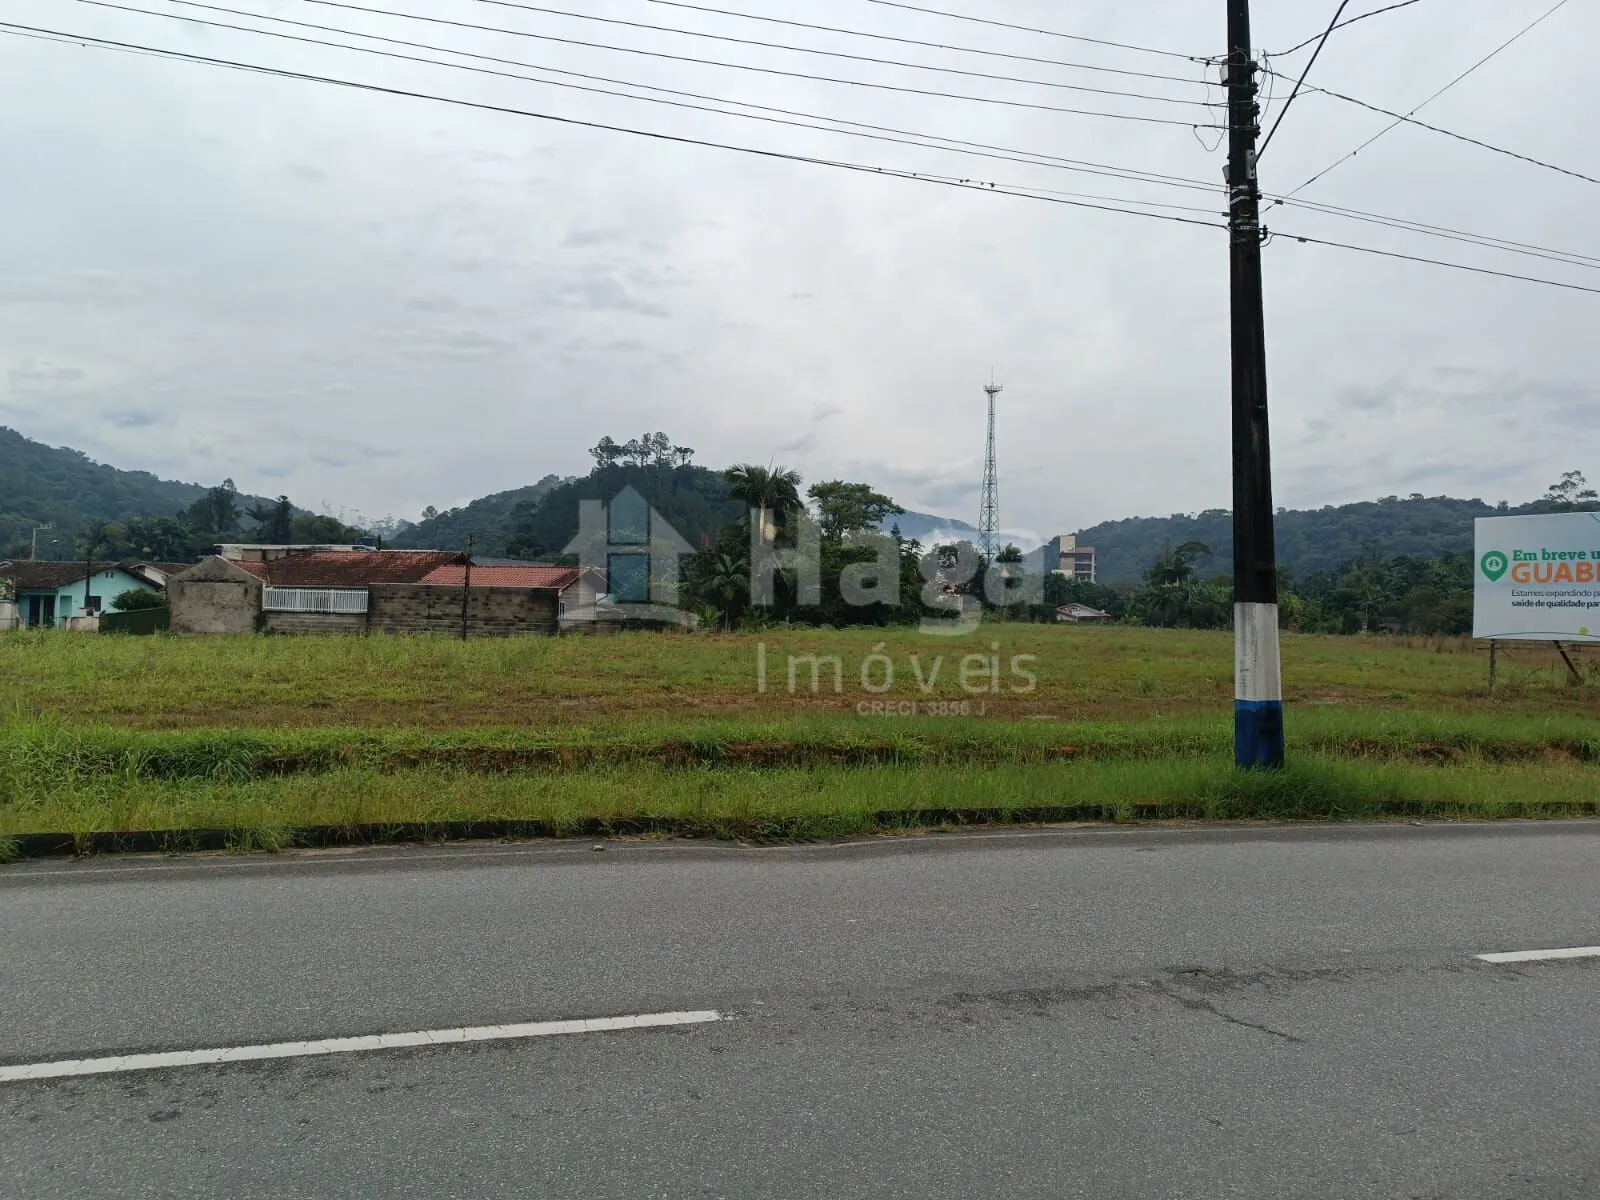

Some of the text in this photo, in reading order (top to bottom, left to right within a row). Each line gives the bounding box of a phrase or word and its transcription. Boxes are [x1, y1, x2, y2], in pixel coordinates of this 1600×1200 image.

[1512, 549, 1537, 561] Em
[1541, 548, 1586, 561] breve
[1511, 589, 1544, 597] Estamos
[1545, 589, 1592, 599] expandindo
[1546, 600, 1586, 609] qualidade
